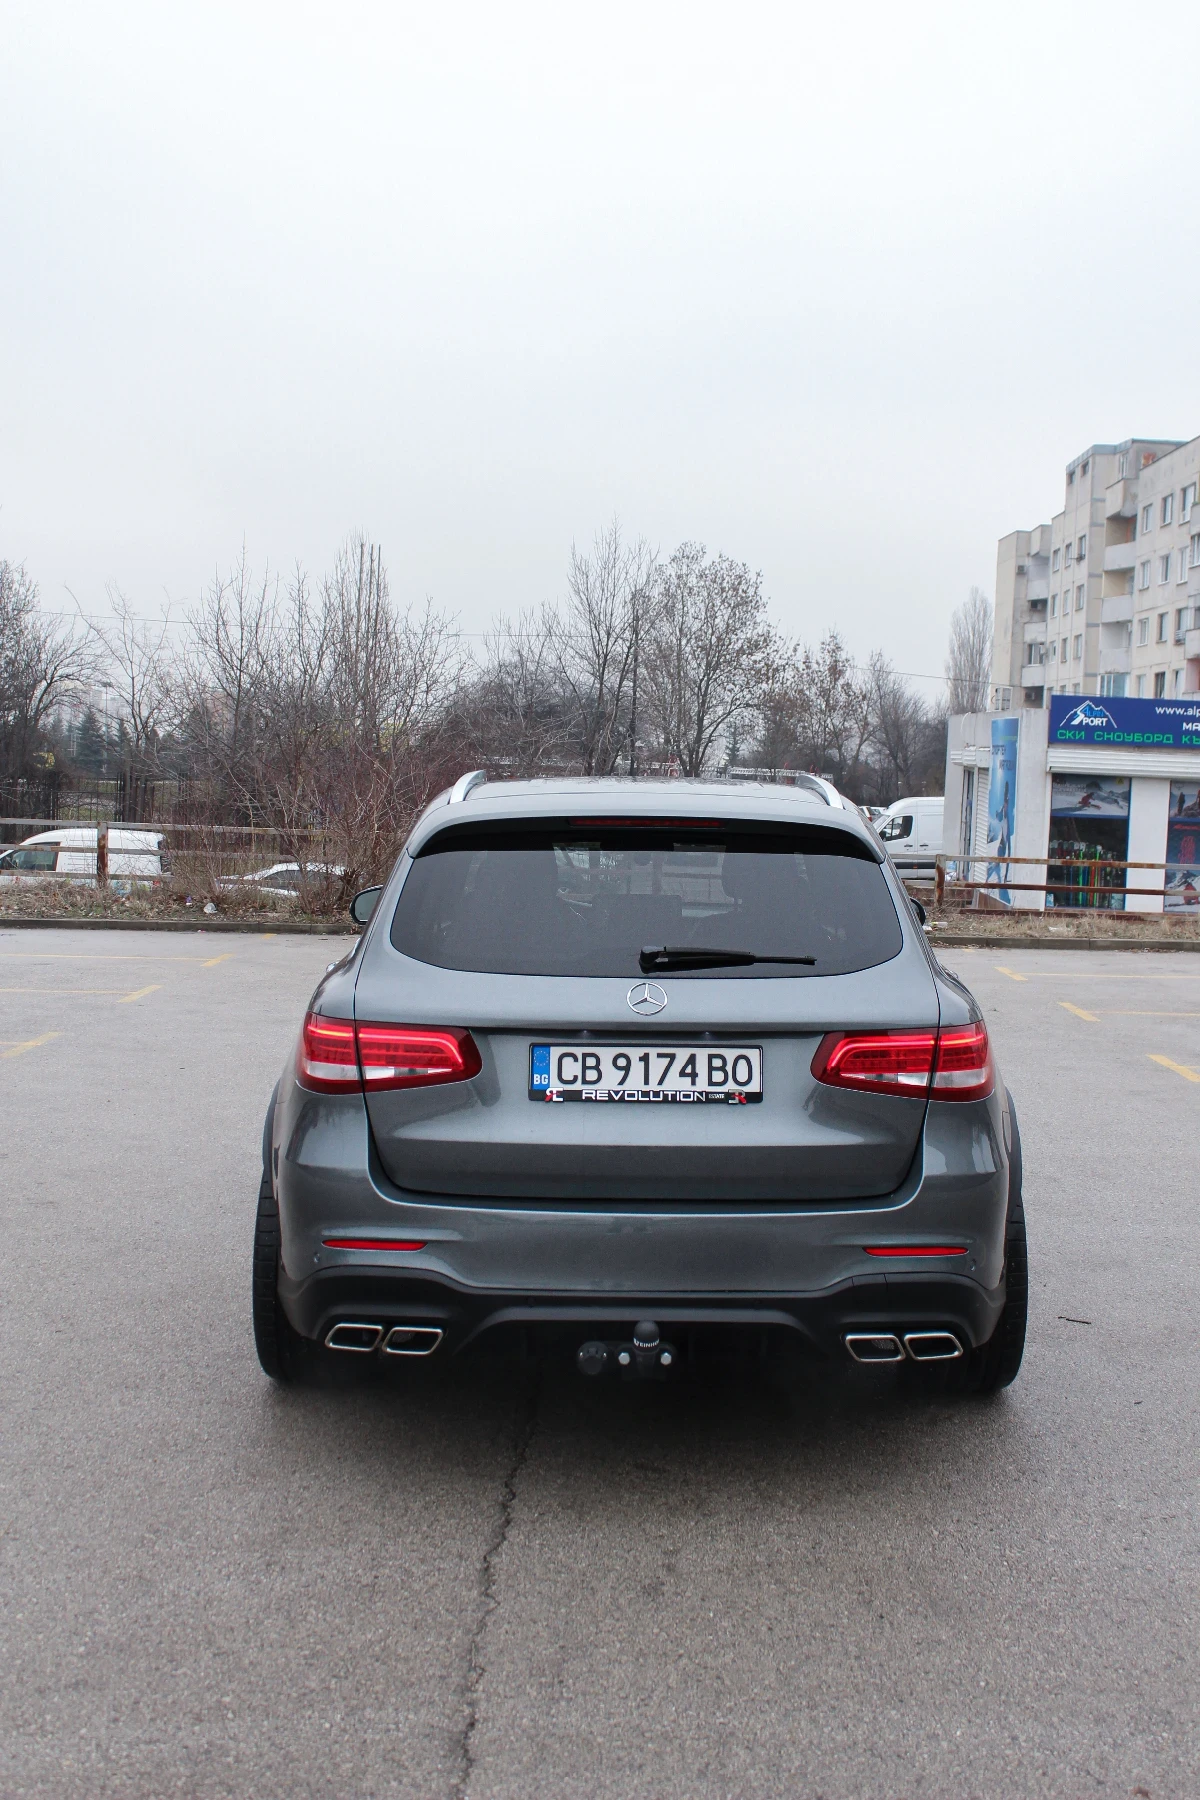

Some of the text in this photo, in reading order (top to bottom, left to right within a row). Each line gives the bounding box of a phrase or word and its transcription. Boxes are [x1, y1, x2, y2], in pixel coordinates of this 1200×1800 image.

[1070, 710, 1108, 726] SPORT
[1057, 730, 1085, 739] СКИ
[1094, 731, 1174, 744] СНОУБОРД
[533, 1074, 549, 1085] BG
[581, 1089, 706, 1102] REVOLUTION
